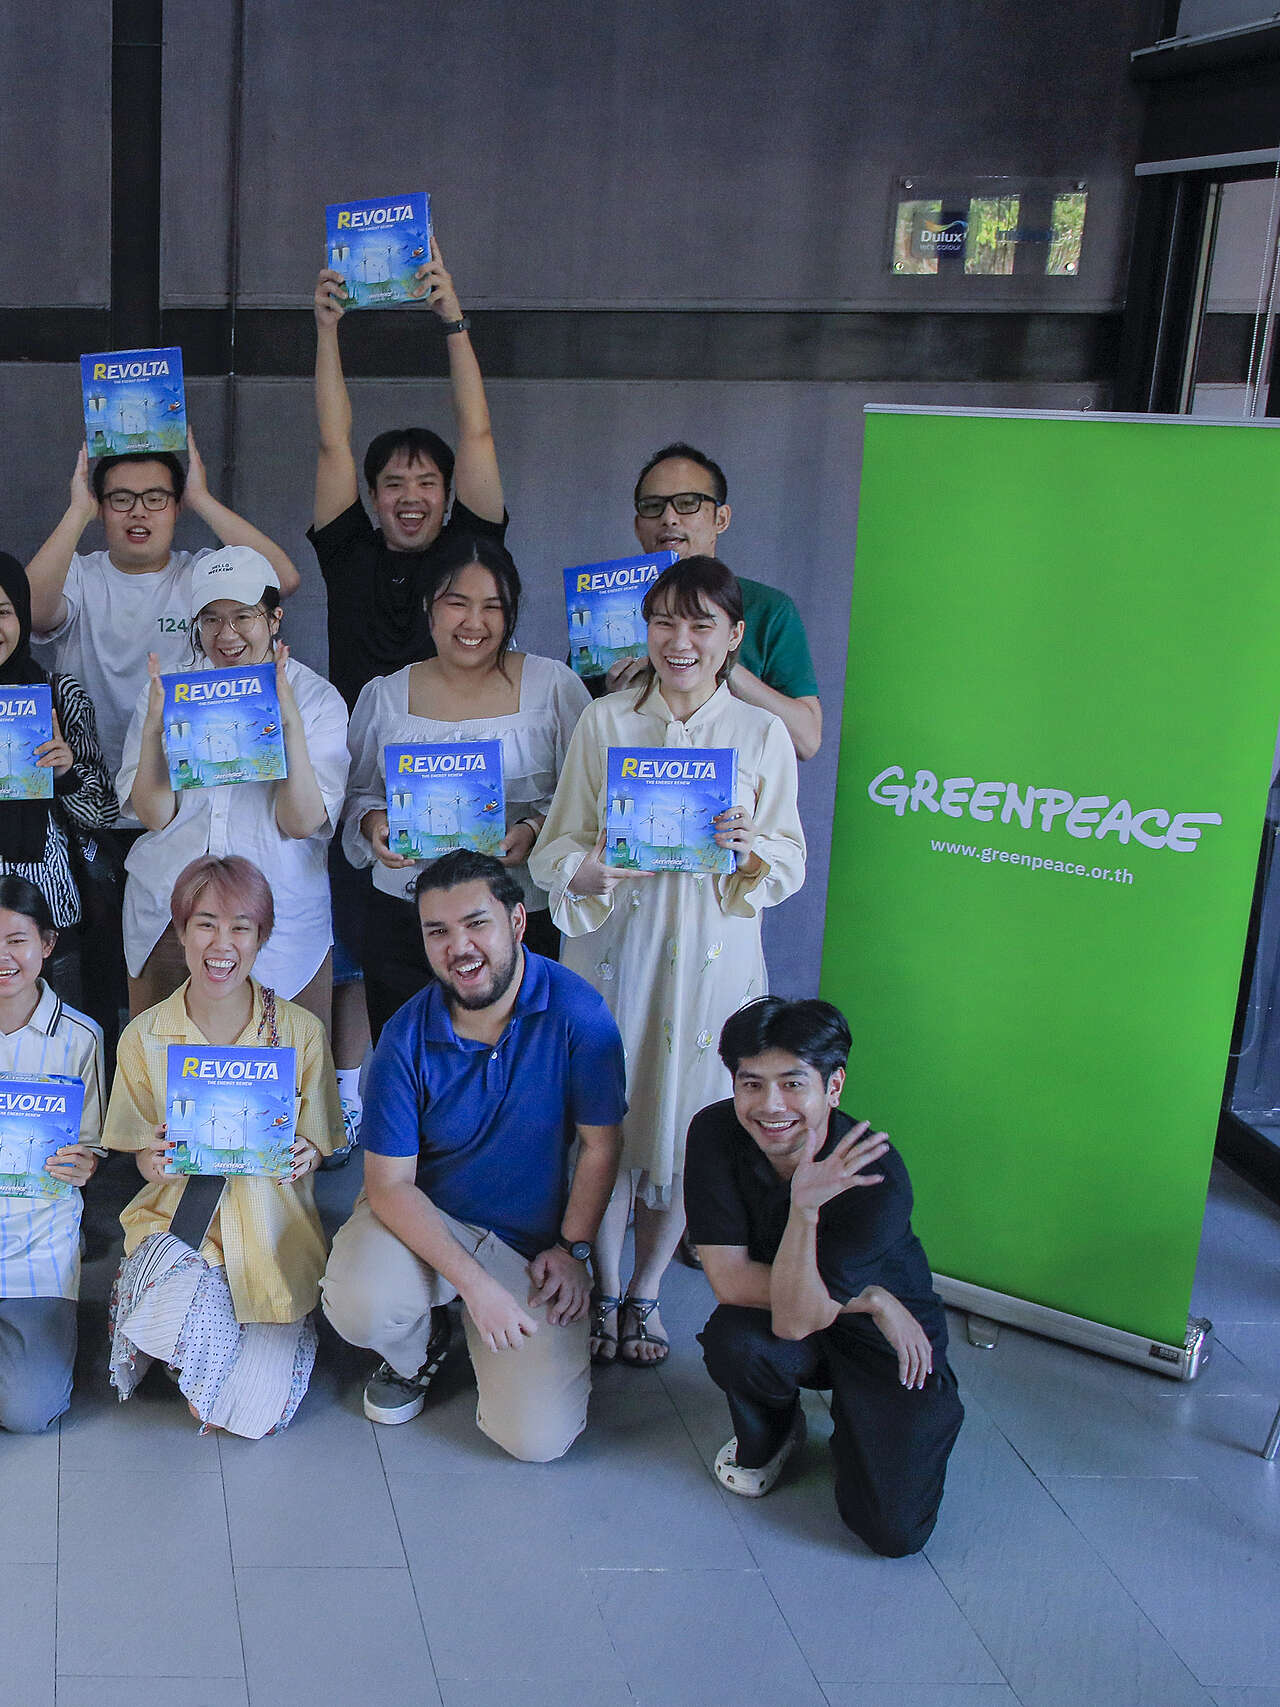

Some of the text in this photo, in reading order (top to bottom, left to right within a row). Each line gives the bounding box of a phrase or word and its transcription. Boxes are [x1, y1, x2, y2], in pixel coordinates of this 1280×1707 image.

[337, 205, 414, 229] REVOLTA
[921, 231, 962, 243] Dulux
[93, 360, 170, 380] REVOLTA
[577, 565, 659, 592] REVOLTA
[174, 677, 262, 703] REVOLTA
[398, 754, 486, 773] REVOLTA
[621, 758, 716, 779] REVOLTA
[868, 766, 1222, 852] GREENPEACE
[930, 839, 1134, 885] www.greenpeace.or.th
[182, 1057, 279, 1080] REVOLTA
